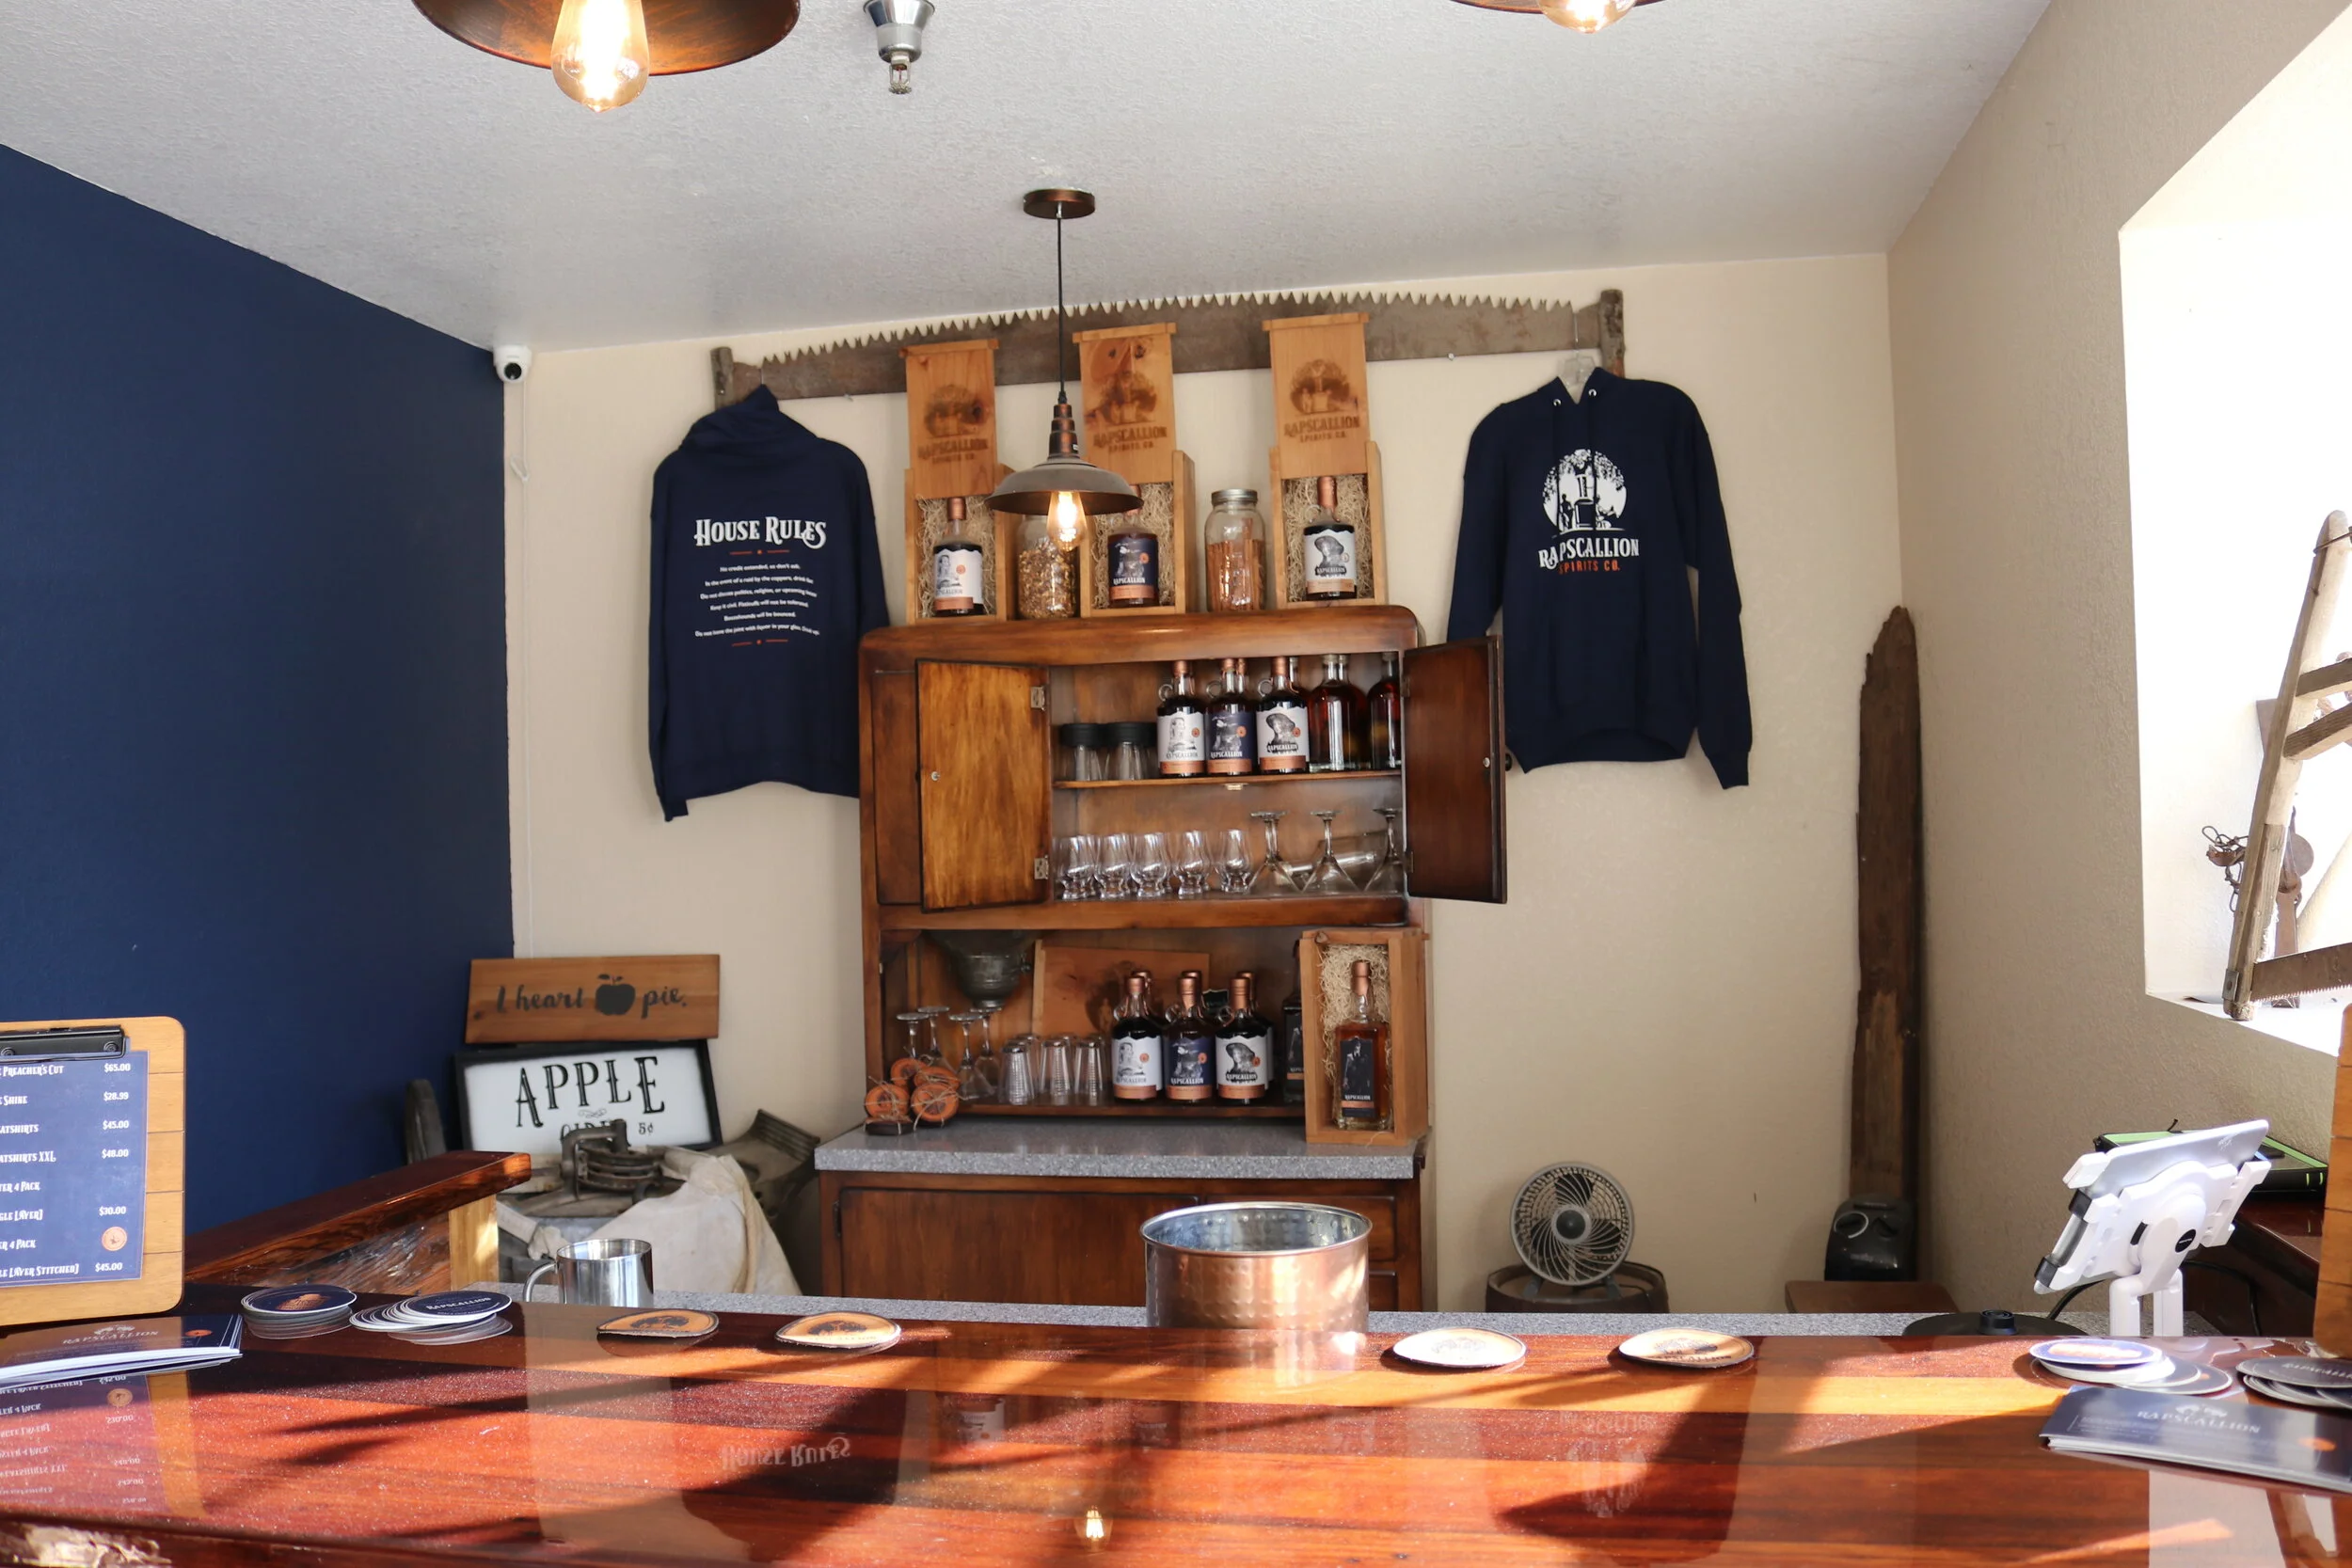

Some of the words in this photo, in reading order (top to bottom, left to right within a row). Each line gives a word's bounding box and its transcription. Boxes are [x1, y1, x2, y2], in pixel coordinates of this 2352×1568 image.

[1284, 416, 1360, 437] RAPSCALLION
[1093, 426, 1168, 448] RAPSCALLION
[693, 518, 761, 546] HOUSE
[765, 516, 827, 549] RULES
[1538, 537, 1640, 570] RAPSCALLION
[1558, 560, 1598, 575] SPIRITS
[1603, 559, 1621, 572] CO.
[1210, 751, 1243, 759] RAPSCALLION
[496, 985, 509, 1014] I
[516, 985, 584, 1012] heart
[640, 985, 689, 1020] pie.
[3, 1064, 47, 1078] PREACHER'S
[48, 1064, 65, 1077] CUT
[104, 1063, 132, 1074] $65.00
[1170, 1076, 1204, 1085] RAPSCALLION
[3, 1095, 28, 1106] SHINE
[103, 1091, 130, 1103] $28.99
[515, 1055, 666, 1129] APPLE
[103, 1120, 130, 1132] $45.00
[38, 1150, 56, 1163] XXL
[102, 1148, 129, 1160] $48.00
[13, 1182, 20, 1192] 4
[21, 1180, 40, 1192] PACK
[99, 1206, 127, 1217] $30.00
[8, 1240, 15, 1249] 4
[16, 1238, 36, 1250] PACK
[8, 1266, 35, 1278] LAYER
[36, 1262, 80, 1276] STITCHED]
[94, 1261, 123, 1274] $45.00
[426, 1297, 492, 1310] RAPSCALLION
[62, 1330, 159, 1344] RAPSCALLION
[2137, 1410, 2261, 1434] RAPSCALLION
